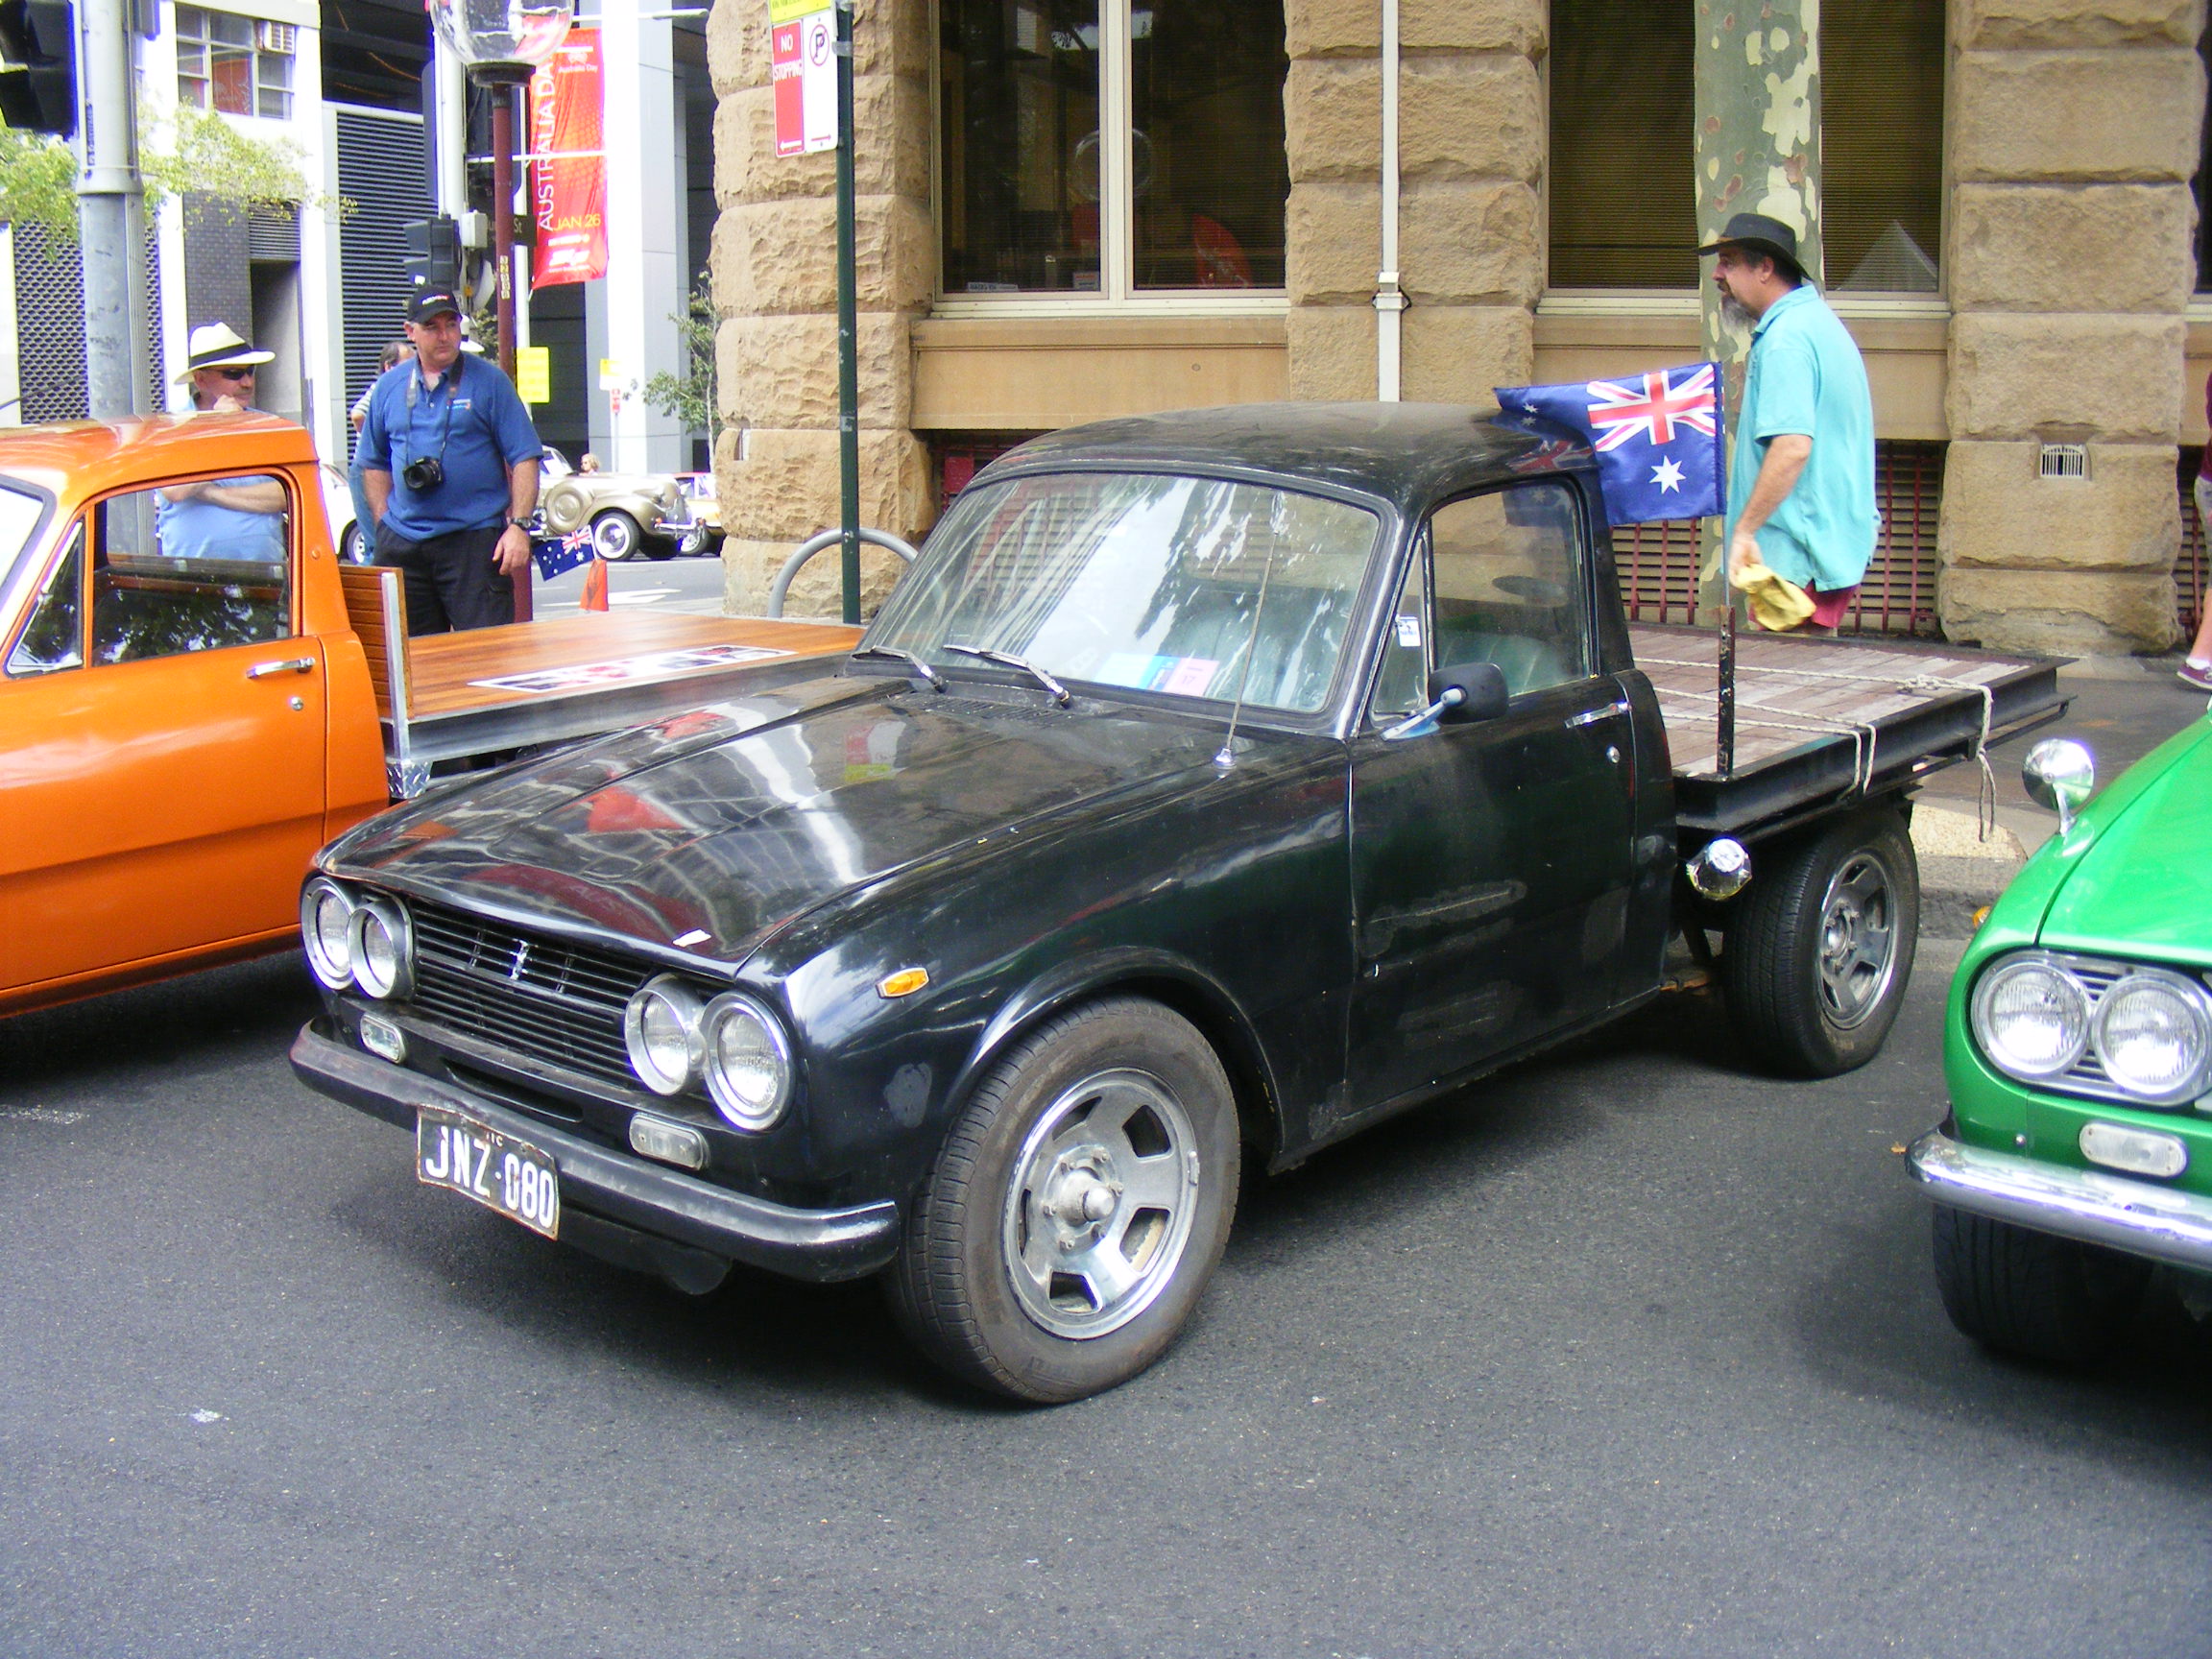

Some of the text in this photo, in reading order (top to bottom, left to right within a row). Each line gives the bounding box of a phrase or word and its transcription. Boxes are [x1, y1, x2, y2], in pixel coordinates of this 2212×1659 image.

[781, 34, 794, 53] NO
[586, 63, 598, 73] Day
[774, 59, 802, 83] STOPPING
[537, 56, 556, 231] AUSTRALIA DA
[552, 213, 601, 230] JAN 26
